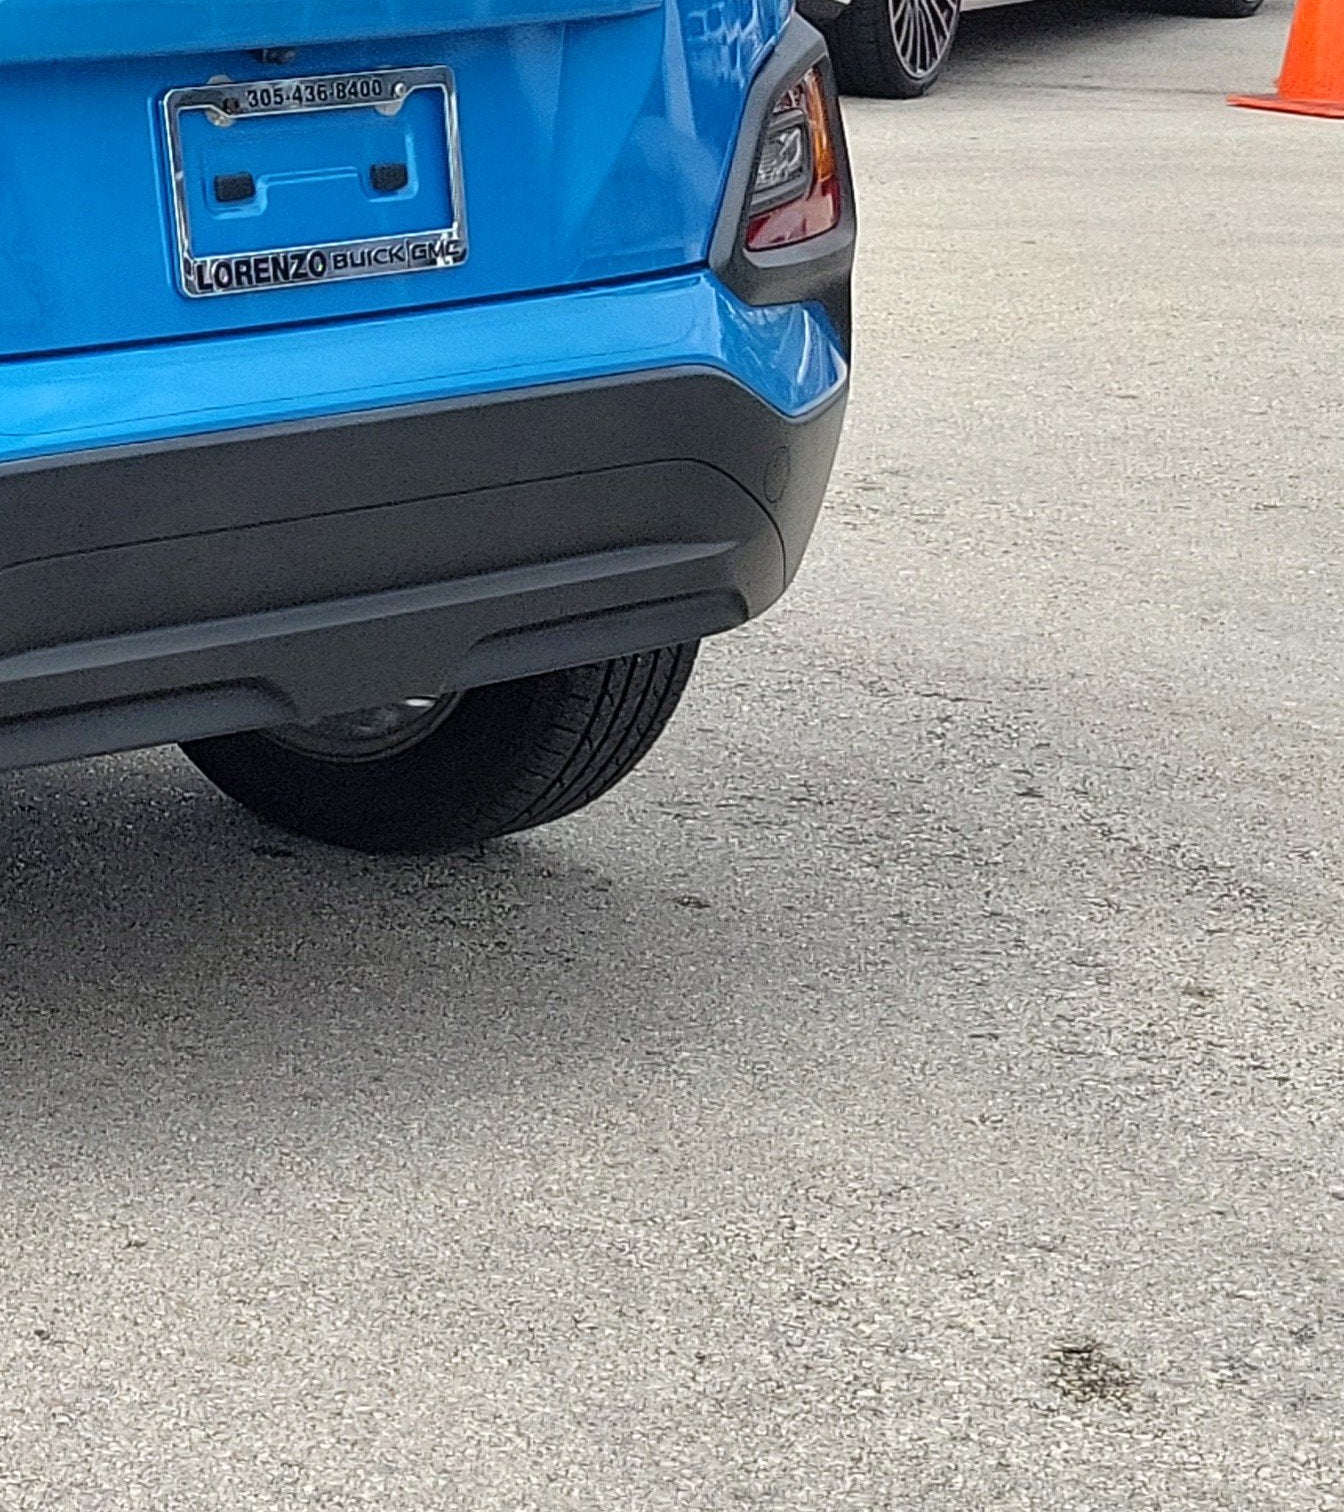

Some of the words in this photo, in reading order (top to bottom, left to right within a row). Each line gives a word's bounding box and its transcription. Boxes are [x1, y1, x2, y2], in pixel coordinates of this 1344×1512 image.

[195, 248, 327, 291] LORENZO
[330, 244, 407, 271] BUICK
[411, 238, 462, 261] GMC
